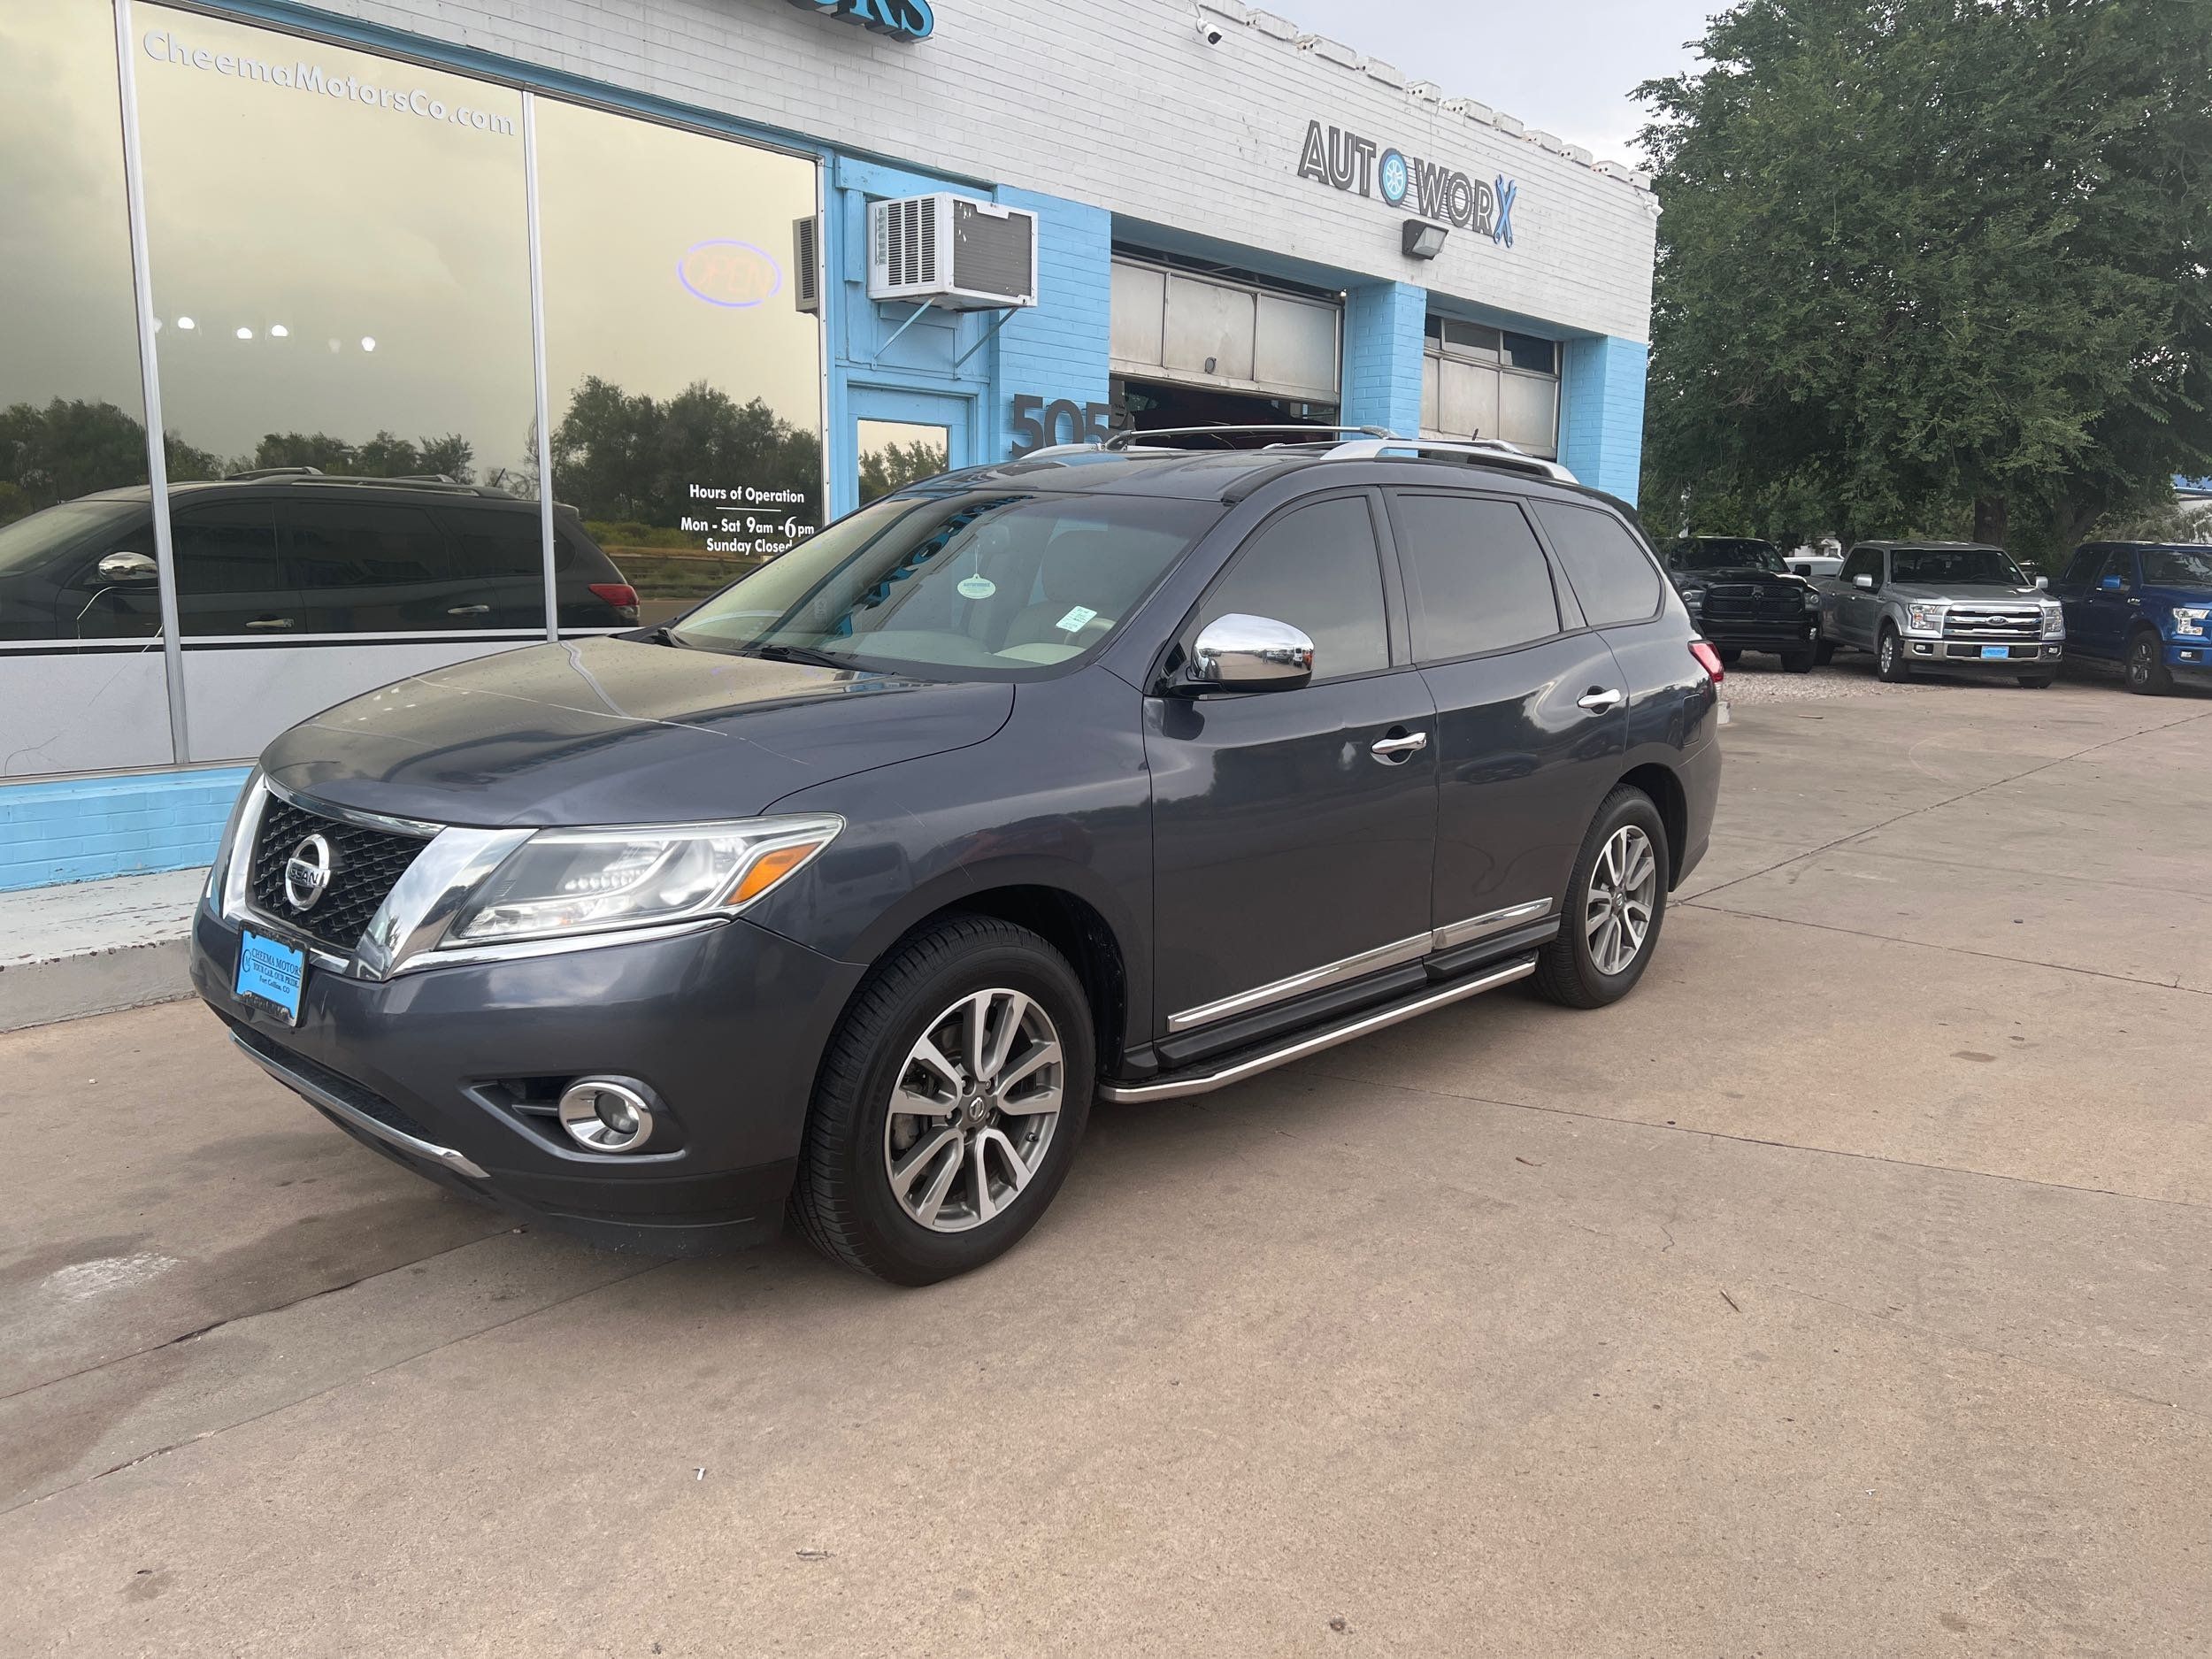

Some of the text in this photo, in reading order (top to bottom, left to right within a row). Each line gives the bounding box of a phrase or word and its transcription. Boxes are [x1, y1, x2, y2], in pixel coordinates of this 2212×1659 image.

[143, 29, 516, 136] CheemaMotorsCo.com
[1011, 393, 1117, 459] 505
[689, 484, 805, 504] Hours of Operation
[680, 517, 709, 531] Mon
[721, 518, 741, 533] Sat
[746, 517, 773, 534] 9am
[706, 538, 752, 555] Sunday
[251, 948, 302, 976] CHEEMA MOTORS
